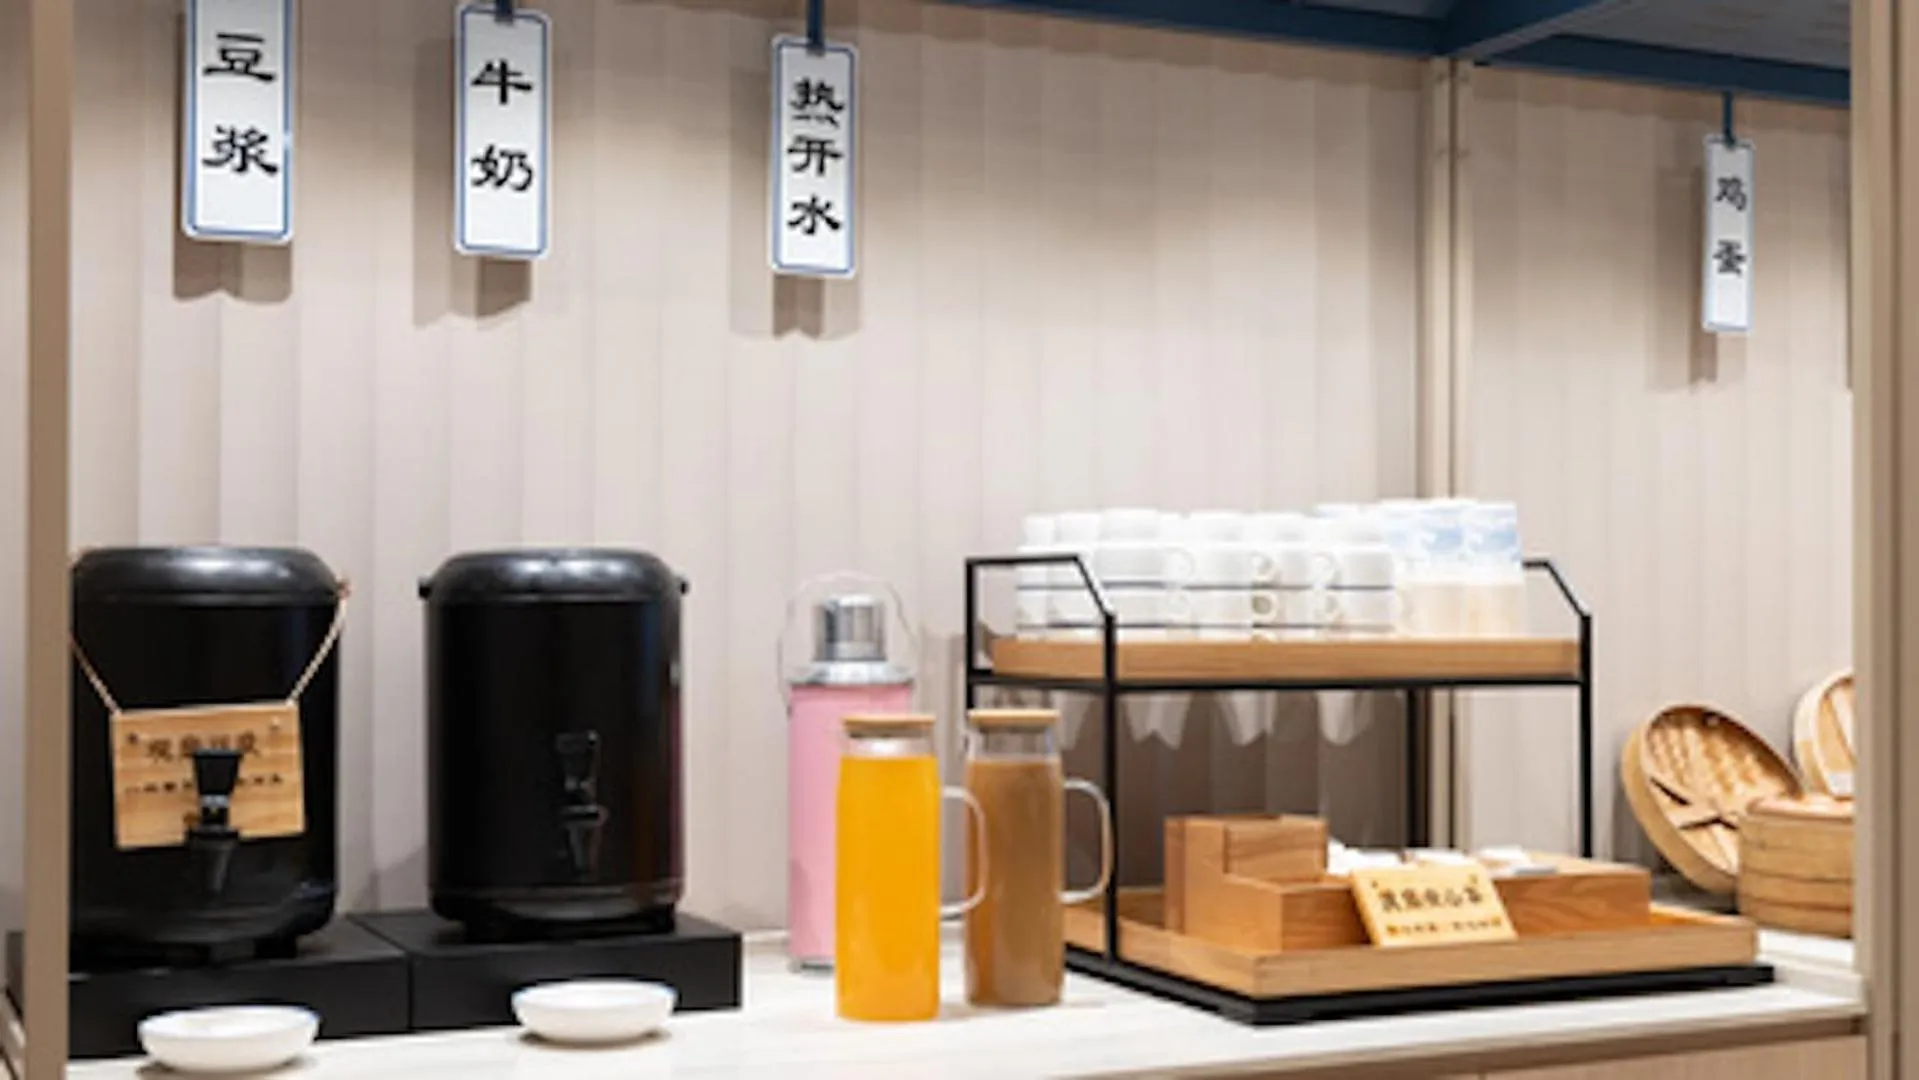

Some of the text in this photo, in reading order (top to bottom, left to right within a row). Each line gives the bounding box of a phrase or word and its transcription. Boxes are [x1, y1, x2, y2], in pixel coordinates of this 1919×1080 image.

[202, 33, 278, 175] 豆浆
[471, 59, 534, 192] 牛奶
[787, 78, 845, 235] 热开水
[1712, 175, 1748, 276] 鸡蛋
